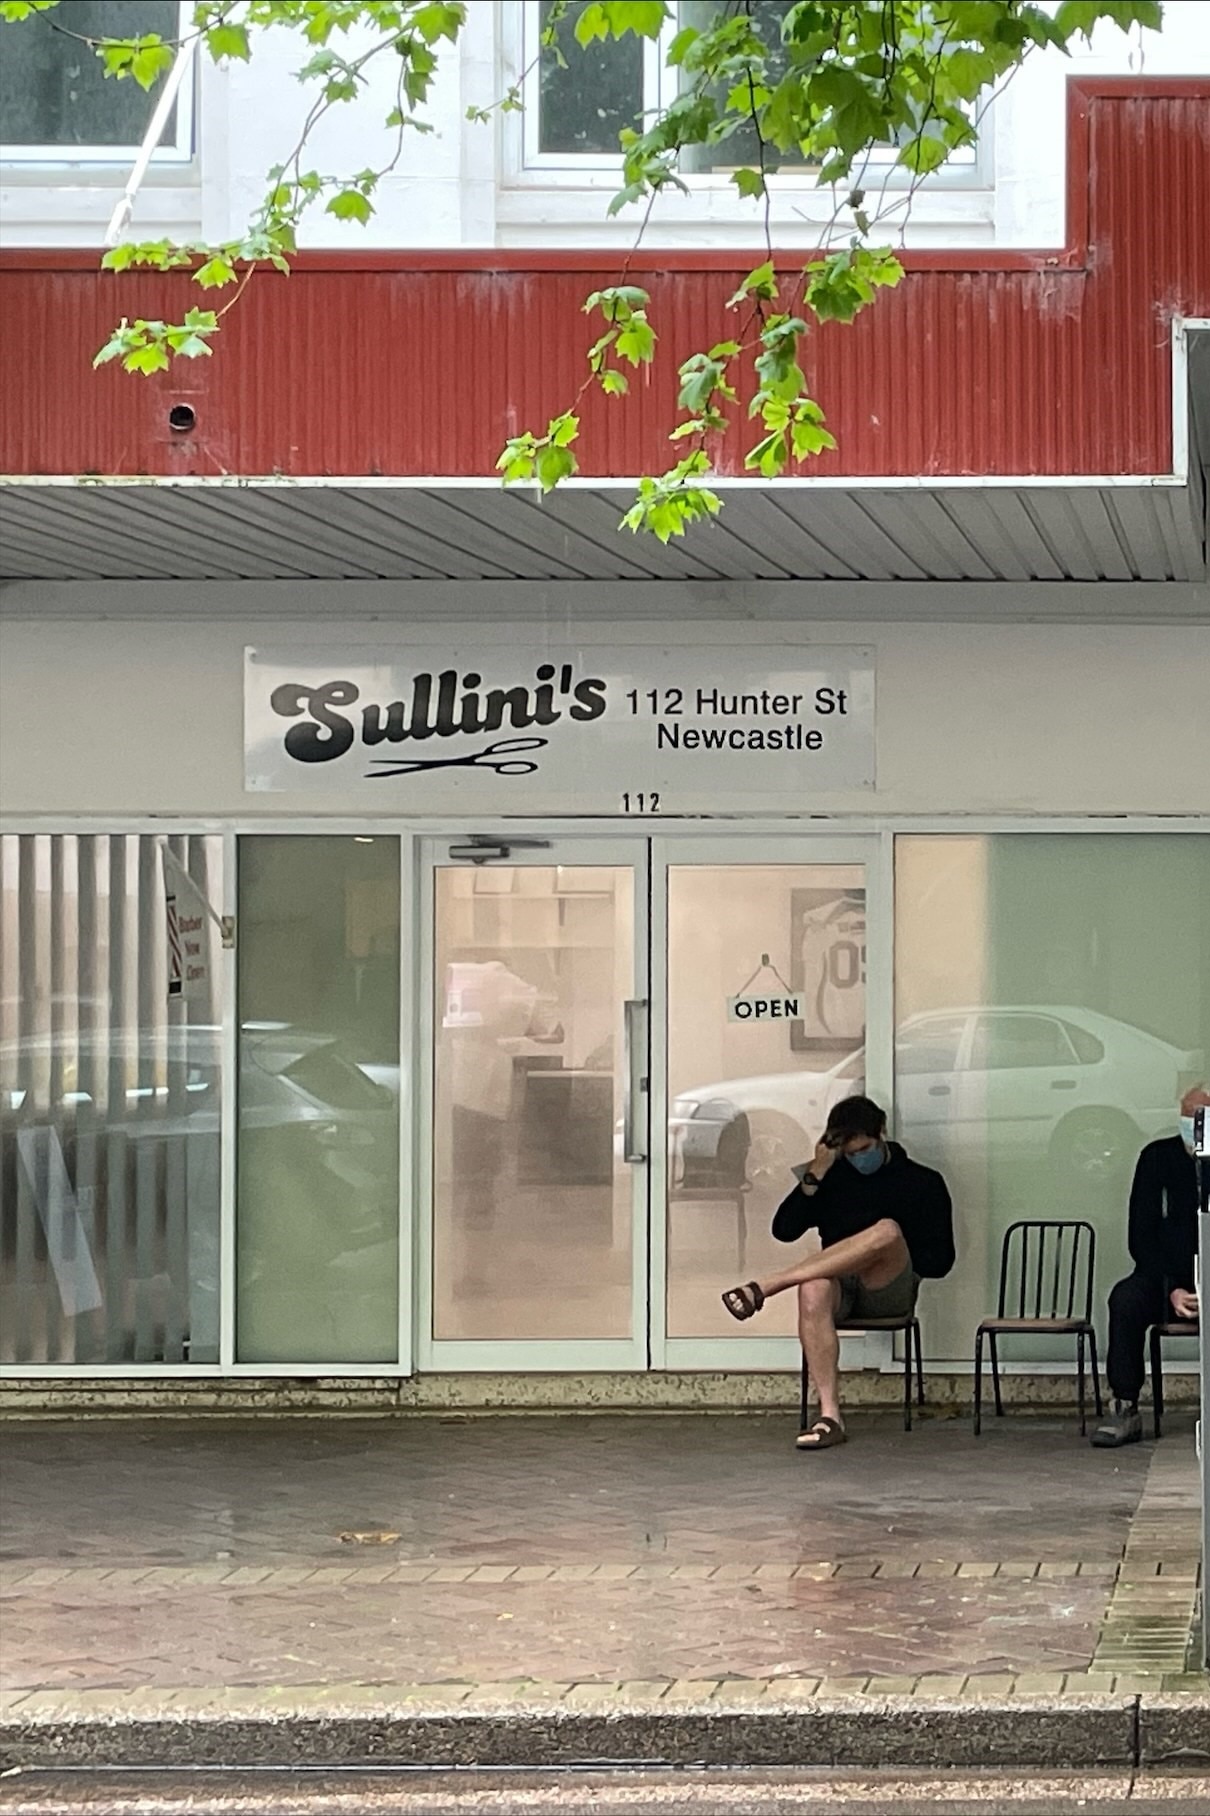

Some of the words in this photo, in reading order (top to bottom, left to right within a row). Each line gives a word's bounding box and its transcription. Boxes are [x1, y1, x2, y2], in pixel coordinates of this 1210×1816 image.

[271, 664, 607, 763] Sullini's
[627, 687, 684, 715] 112
[696, 687, 804, 715] Hunter
[815, 686, 848, 715] St
[657, 723, 823, 751] Newcastle
[623, 792, 660, 812] 112
[735, 999, 798, 1019] OPEN
